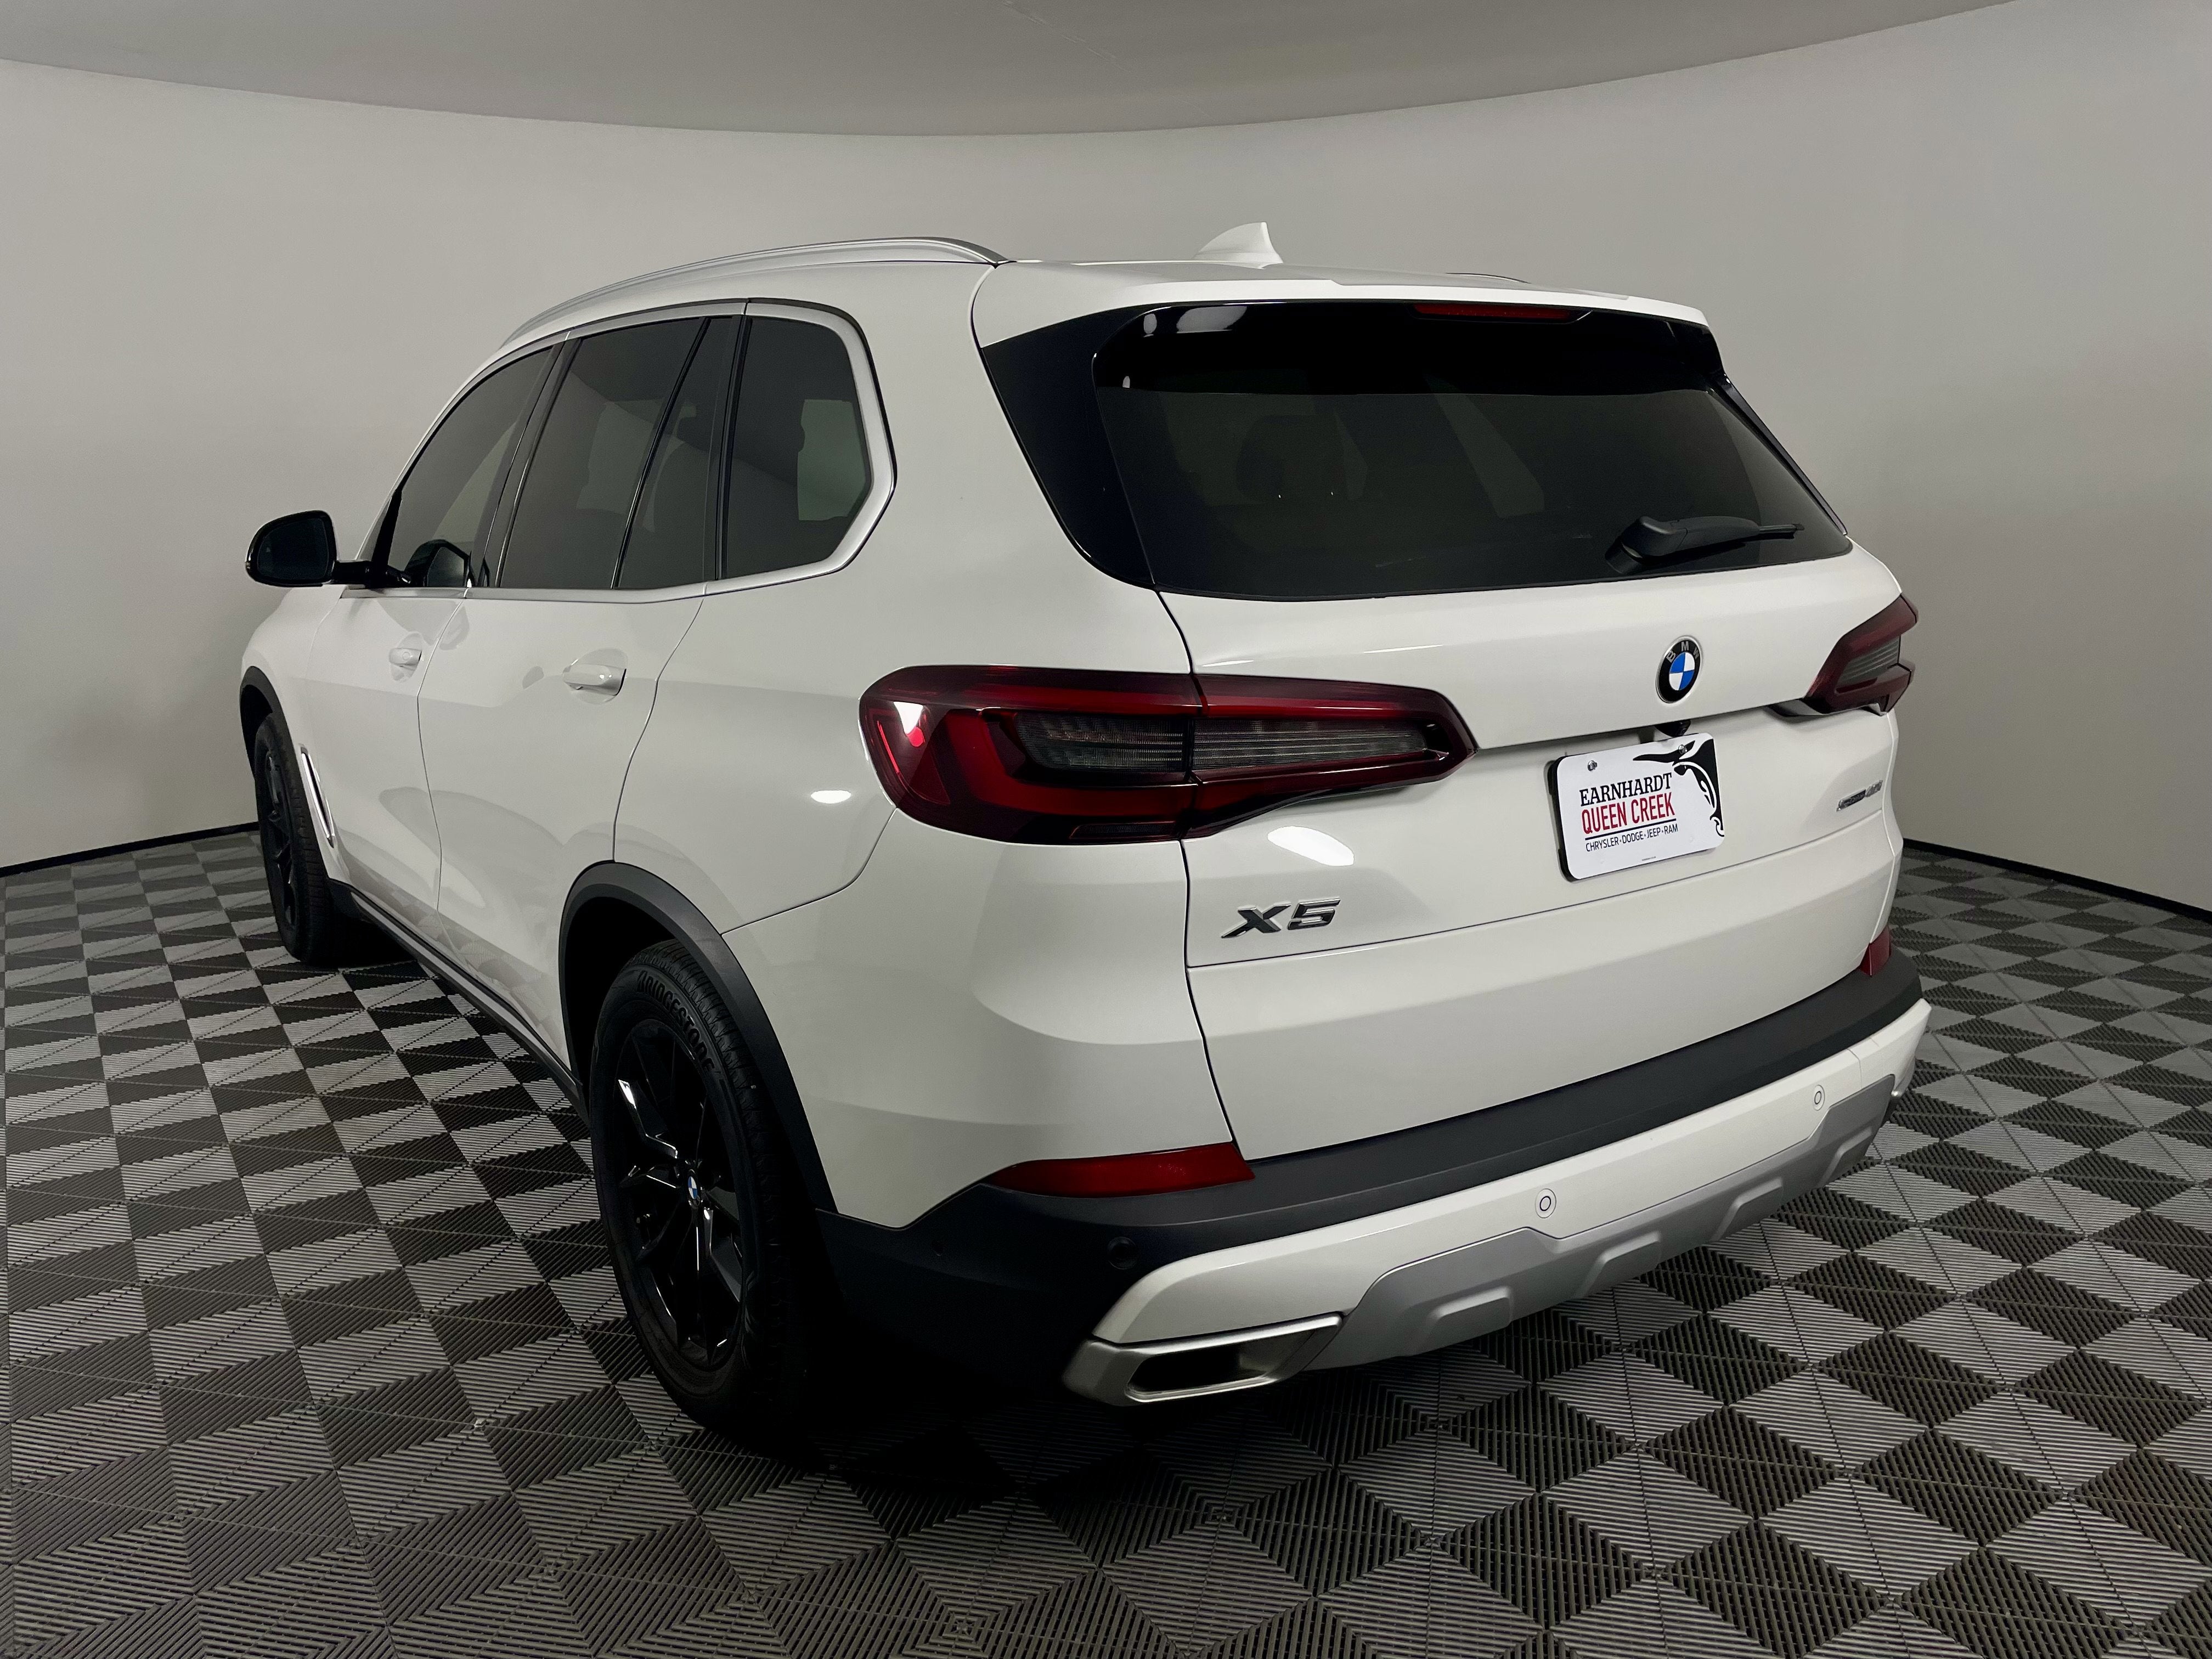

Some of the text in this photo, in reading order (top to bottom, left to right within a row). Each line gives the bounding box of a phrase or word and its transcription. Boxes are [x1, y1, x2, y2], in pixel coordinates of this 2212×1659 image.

[1666, 641, 1700, 663] BMW
[1579, 772, 1672, 806] EARNHARDT
[1582, 792, 1675, 834] QUEEN CREEK
[1221, 896, 1341, 938] X5
[636, 970, 715, 1071] BRIDGESTONE
